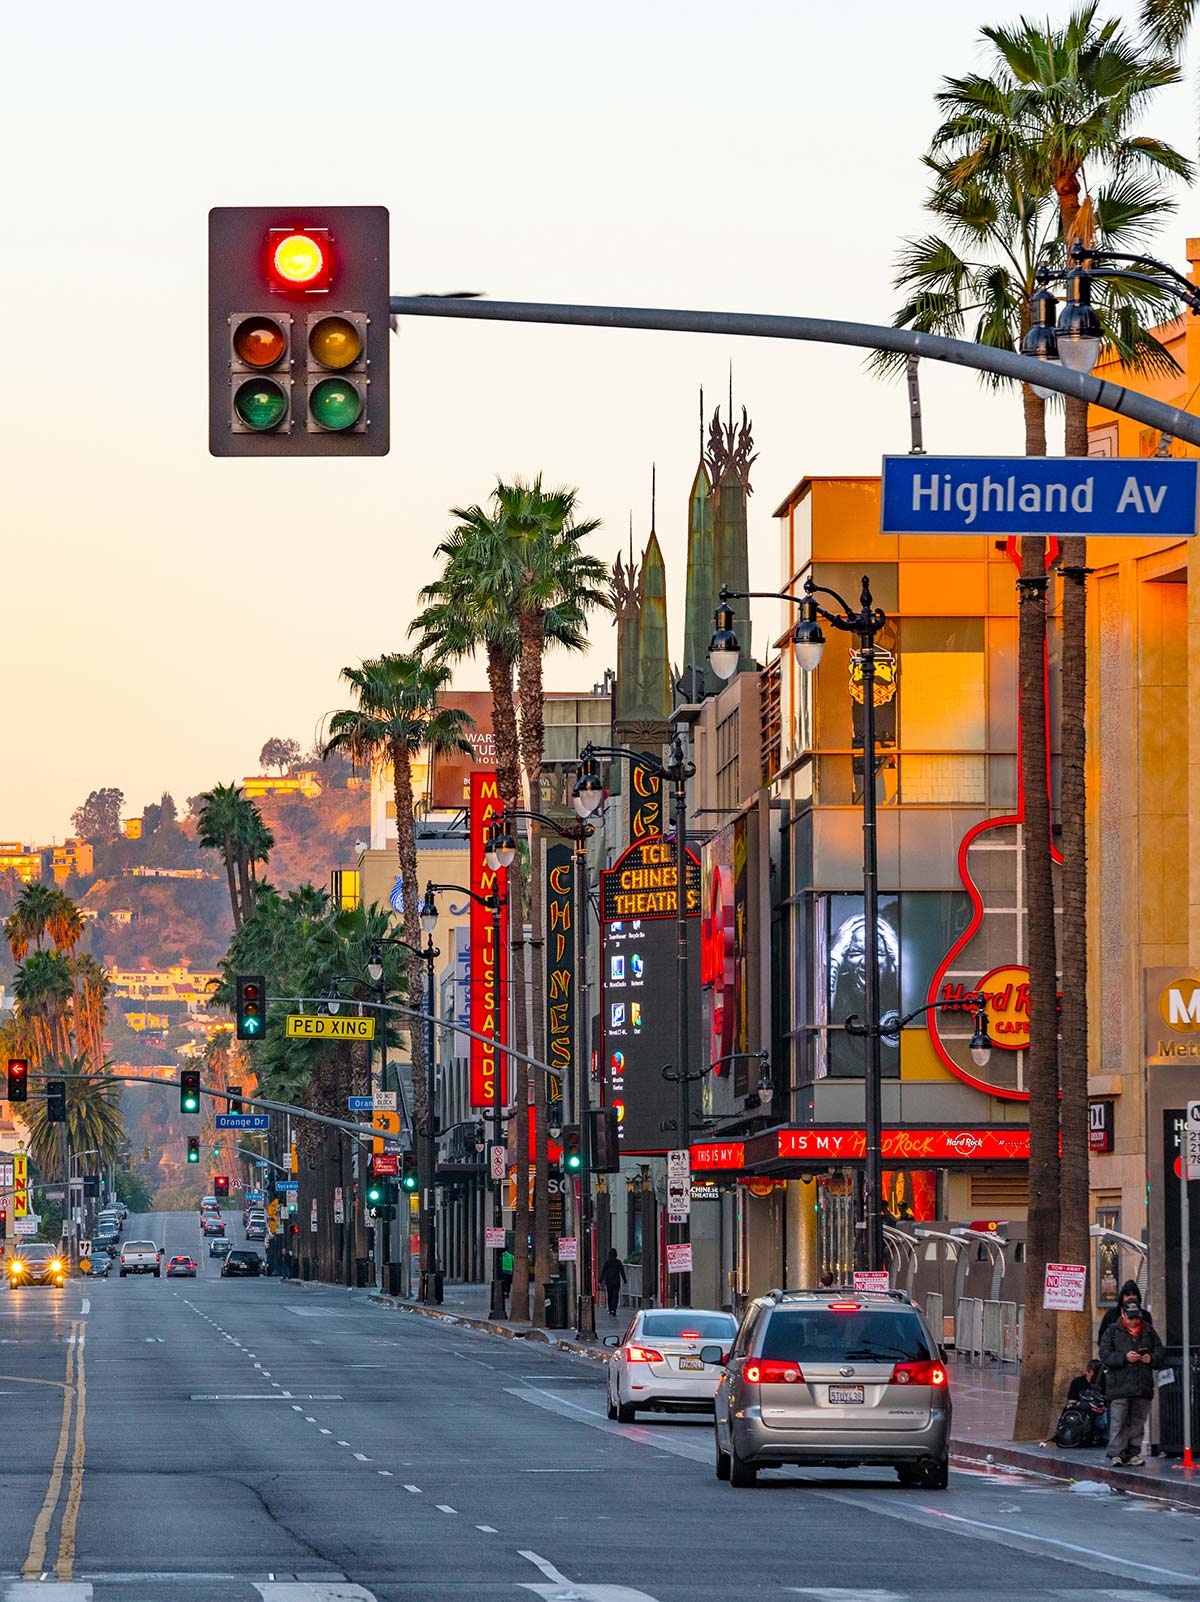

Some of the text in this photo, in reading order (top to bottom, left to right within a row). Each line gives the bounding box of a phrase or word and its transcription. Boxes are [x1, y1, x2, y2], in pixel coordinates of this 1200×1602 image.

[912, 474, 1167, 524] Highland Av
[481, 781, 498, 912] MADME
[640, 844, 670, 865] TCL
[614, 890, 699, 914] THEATRS
[294, 1019, 367, 1035] PED XING
[995, 1021, 1030, 1034] CAFE
[220, 1117, 265, 1127] Orange Dr
[791, 1136, 808, 1149] IS
[816, 1136, 843, 1149] MY
[893, 1132, 935, 1158] ROCK
[946, 1137, 983, 1148] Hard Rock
[698, 1149, 733, 1162] THIS IS MY
[15, 1160, 26, 1211] INN
[855, 1281, 866, 1291] NO
[1046, 1275, 1059, 1287] NO
